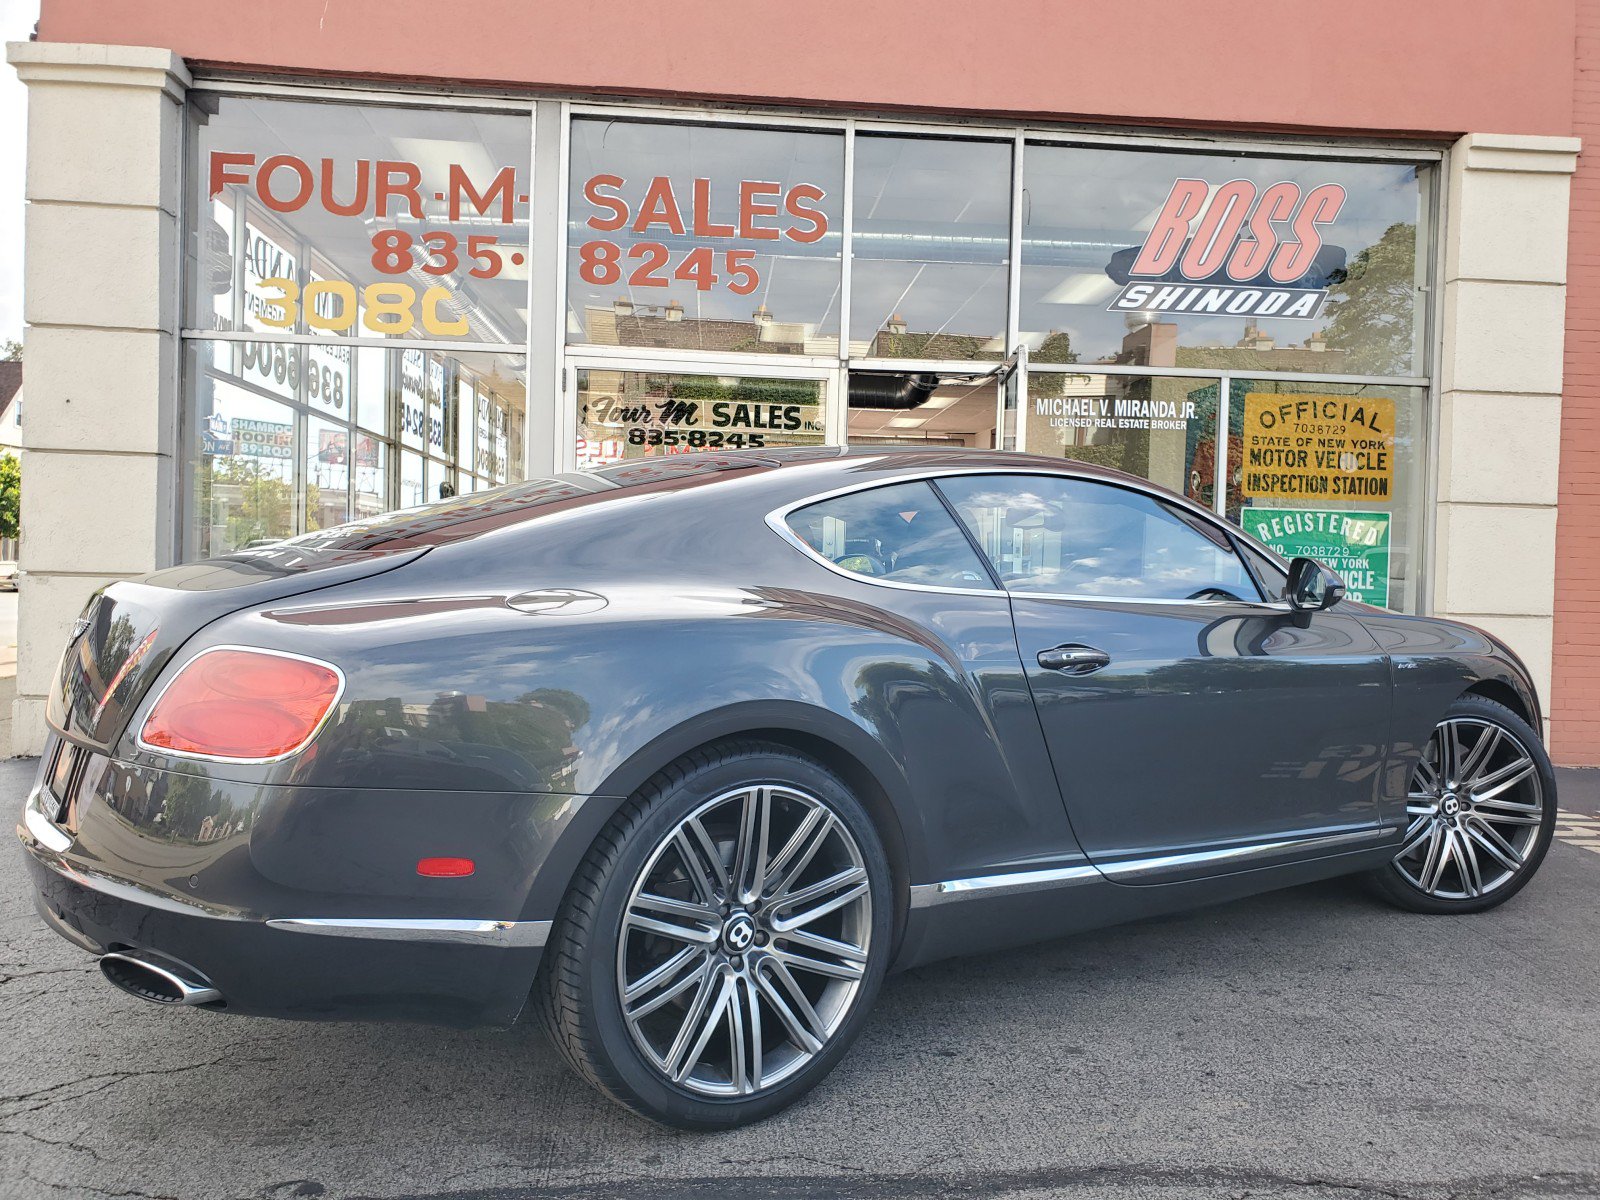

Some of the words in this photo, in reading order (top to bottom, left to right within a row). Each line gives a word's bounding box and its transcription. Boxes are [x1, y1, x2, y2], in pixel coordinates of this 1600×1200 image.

[583, 174, 829, 243] SALES
[1129, 177, 1347, 283] BOSS
[579, 240, 759, 295] 8245
[1117, 285, 1320, 317] SHINODA
[591, 396, 652, 424] Four
[655, 399, 699, 426] M
[712, 402, 801, 431] SALES
[804, 420, 824, 431] INC.
[1036, 398, 1097, 416] MICHAEL
[1099, 399, 1111, 416] V.
[1114, 400, 1176, 418] MIRANDA
[1179, 401, 1199, 419] JR.
[1259, 400, 1382, 434] OFFICIAL
[231, 418, 293, 435] SHAMROC
[1050, 418, 1092, 428] LICENSED
[1094, 418, 1117, 428] REAL
[1118, 419, 1149, 429] ESTATE
[1151, 420, 1187, 430] BROKER
[1251, 436, 1290, 446] STATE
[1296, 437, 1313, 447] OF
[1317, 439, 1345, 449] NEW
[1351, 440, 1386, 450] YORK
[1249, 448, 1309, 468] MOTOR
[1247, 473, 1328, 494] INSPECTION
[1332, 476, 1388, 495] STATION
[1256, 512, 1377, 545] REGISTERED
[1269, 544, 1287, 555] NO.
[1342, 559, 1369, 569] YORK
